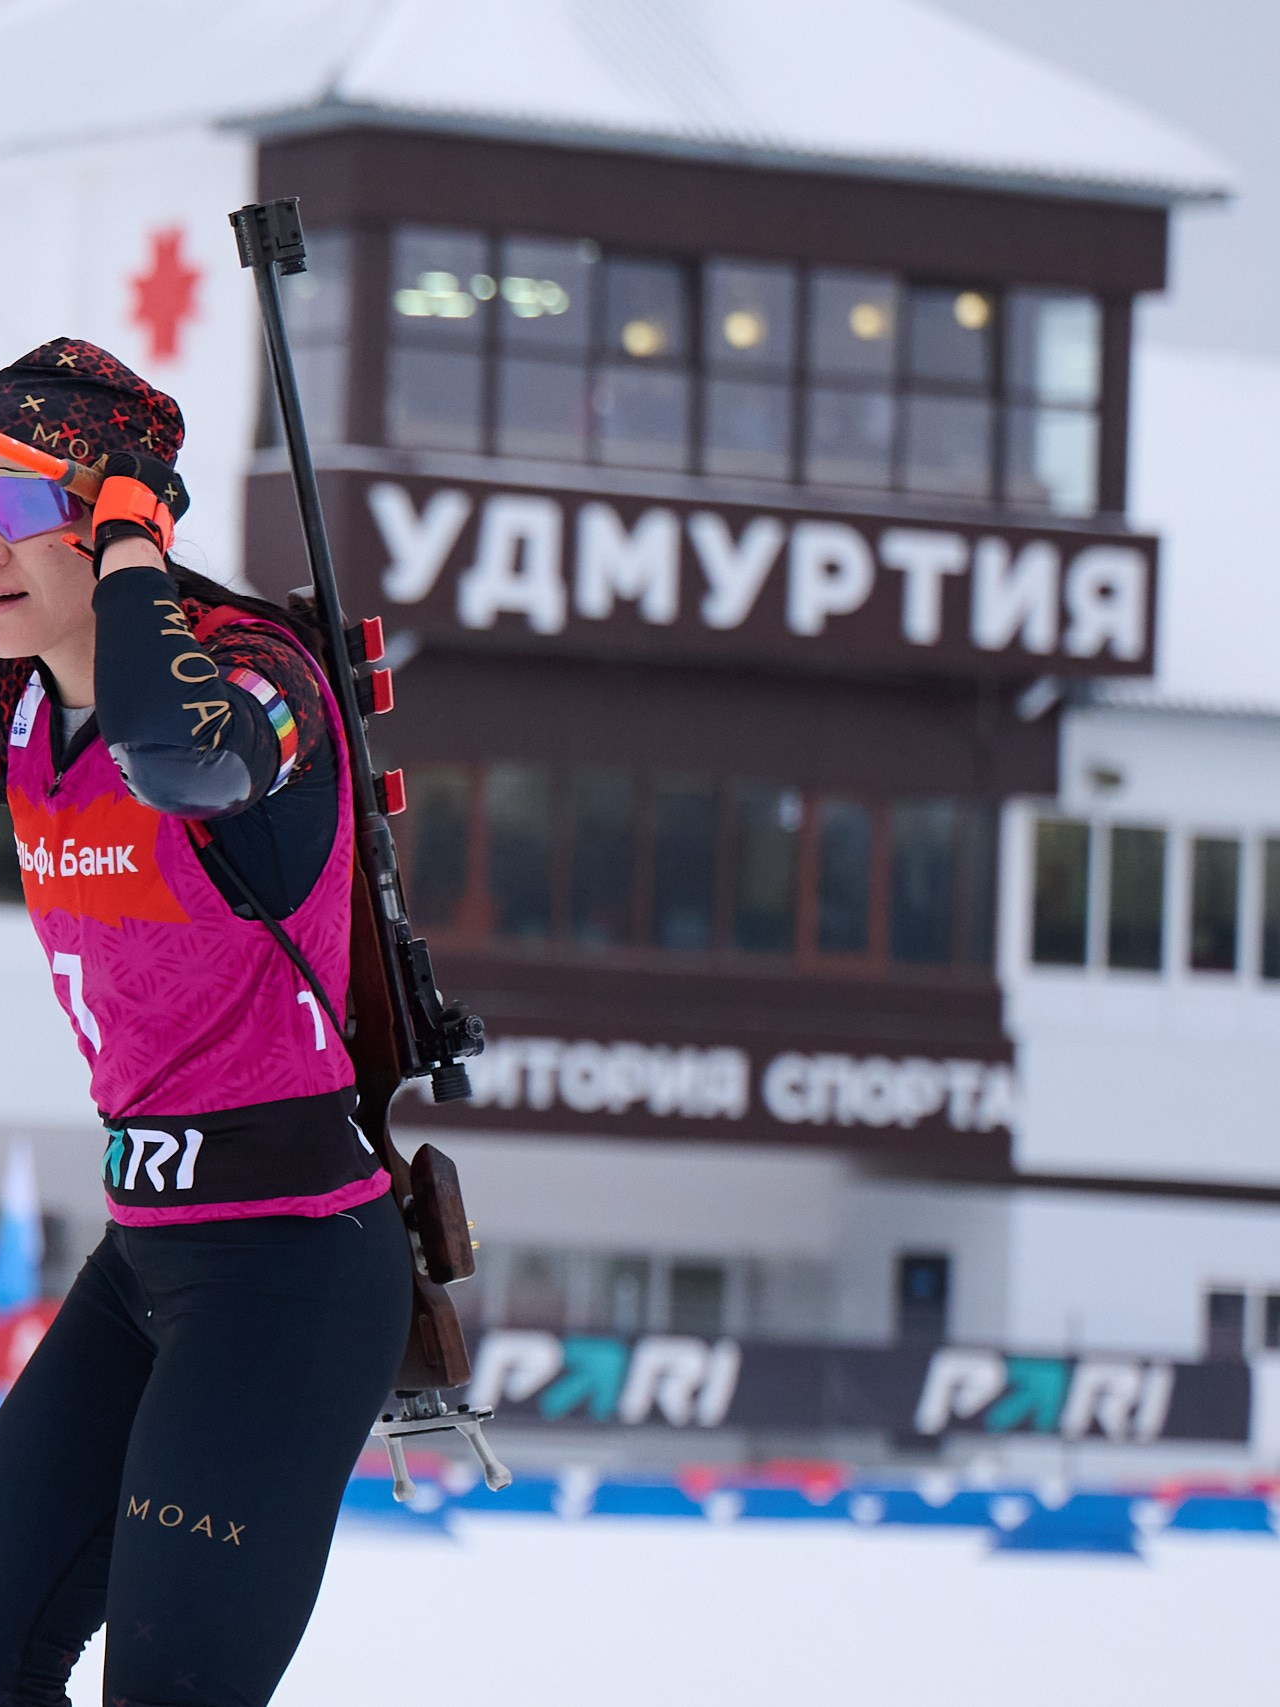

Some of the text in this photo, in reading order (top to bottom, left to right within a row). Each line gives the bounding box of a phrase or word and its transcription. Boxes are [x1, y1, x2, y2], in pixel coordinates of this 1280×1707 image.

[32, 422, 89, 459] MO
[367, 482, 1150, 662] УДМУРТИЯ
[60, 838, 139, 877] Банк
[462, 1035, 1016, 1133] ИТОРИЯ СПОРТА
[468, 1330, 742, 1428] PARI
[914, 1350, 1174, 1439] PARI
[126, 1495, 246, 1547] MOAX
